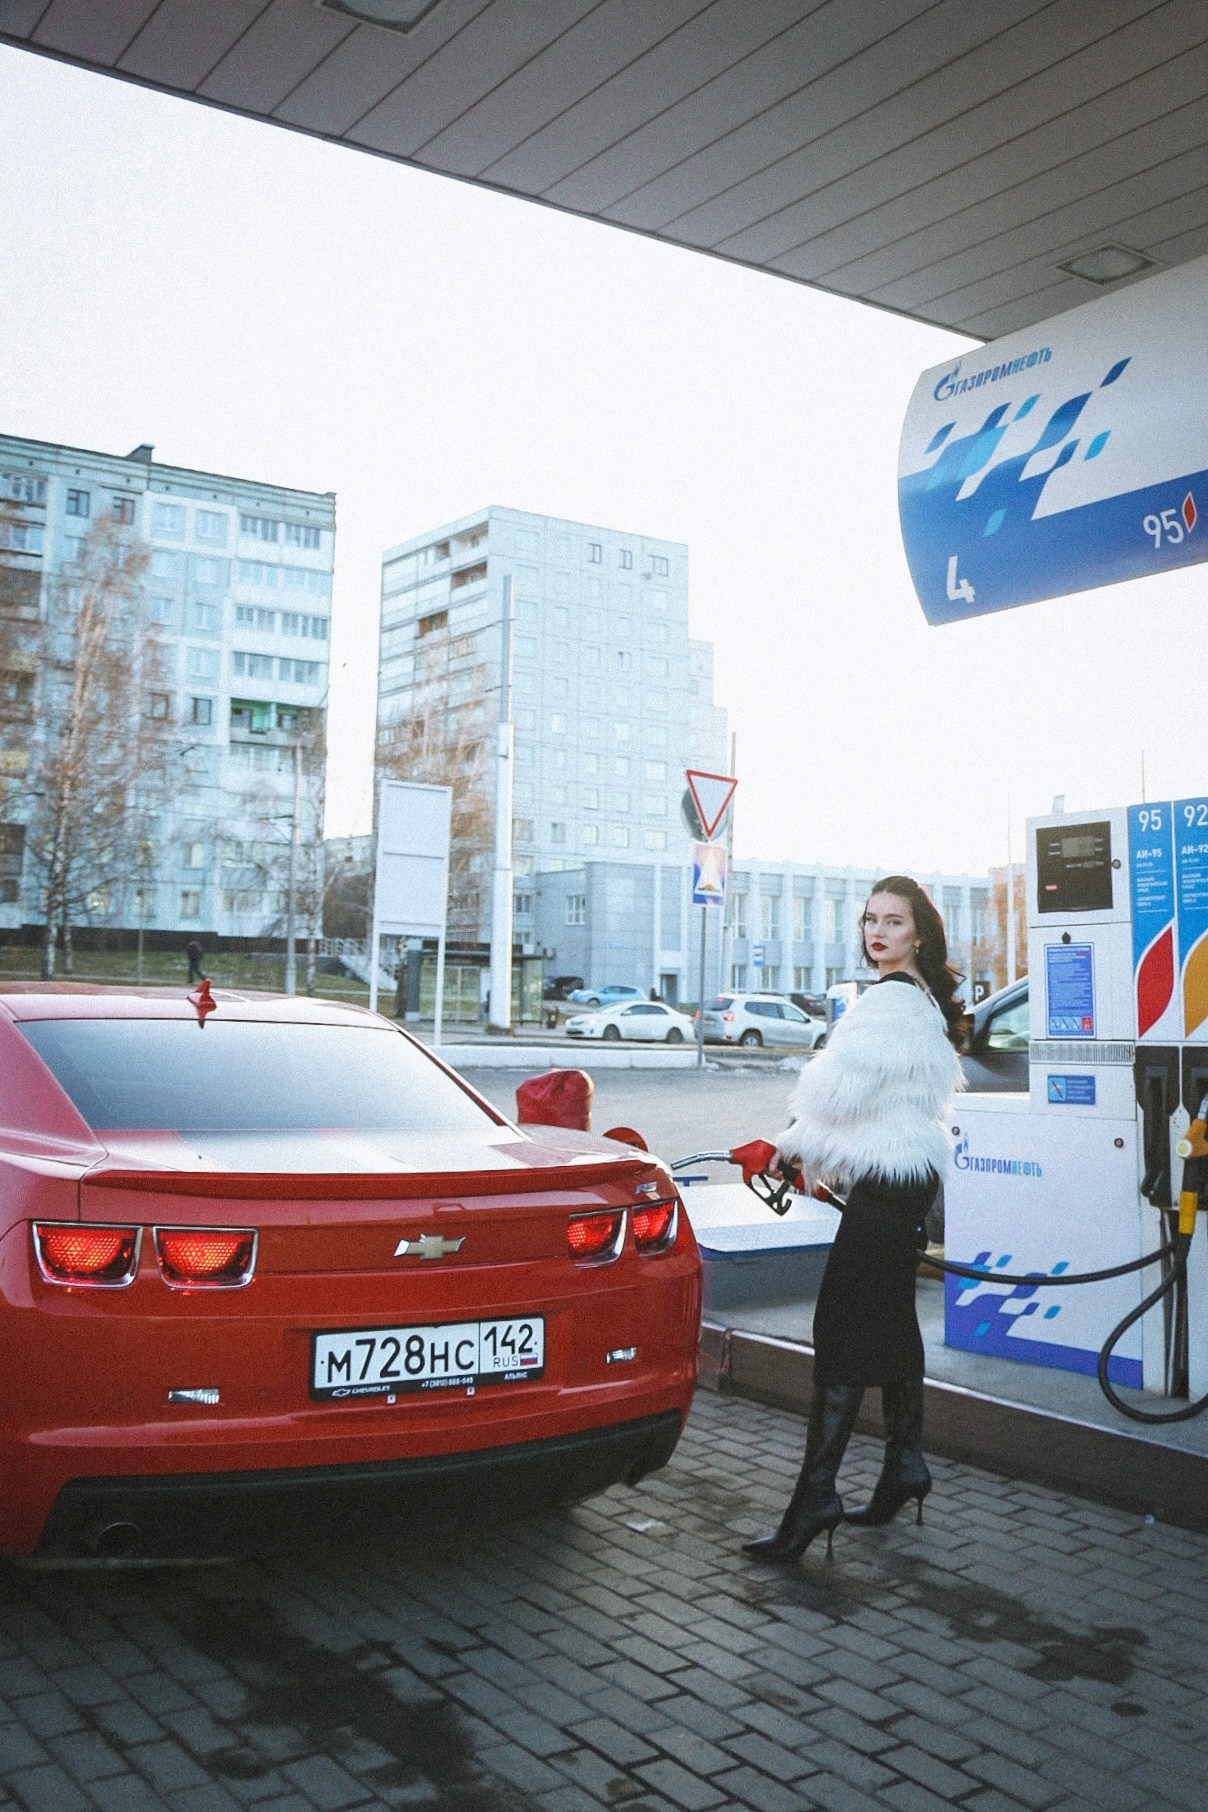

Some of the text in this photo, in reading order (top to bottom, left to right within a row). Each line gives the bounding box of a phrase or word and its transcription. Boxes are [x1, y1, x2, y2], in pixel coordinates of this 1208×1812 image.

[954, 347, 1052, 396] ГАЗПРОМНЕФТЬ
[1143, 509, 1184, 548] 95
[946, 555, 975, 603] 4
[1139, 809, 1162, 832] 95
[1184, 804, 1208, 827] 92
[1136, 848, 1162, 859] АИ-95
[970, 1157, 1042, 1178] ГАЗПРОМНЕФТЬ
[484, 1324, 534, 1356] 142
[493, 1356, 519, 1368] RUS
[352, 1385, 390, 1394] CHEVROLET
